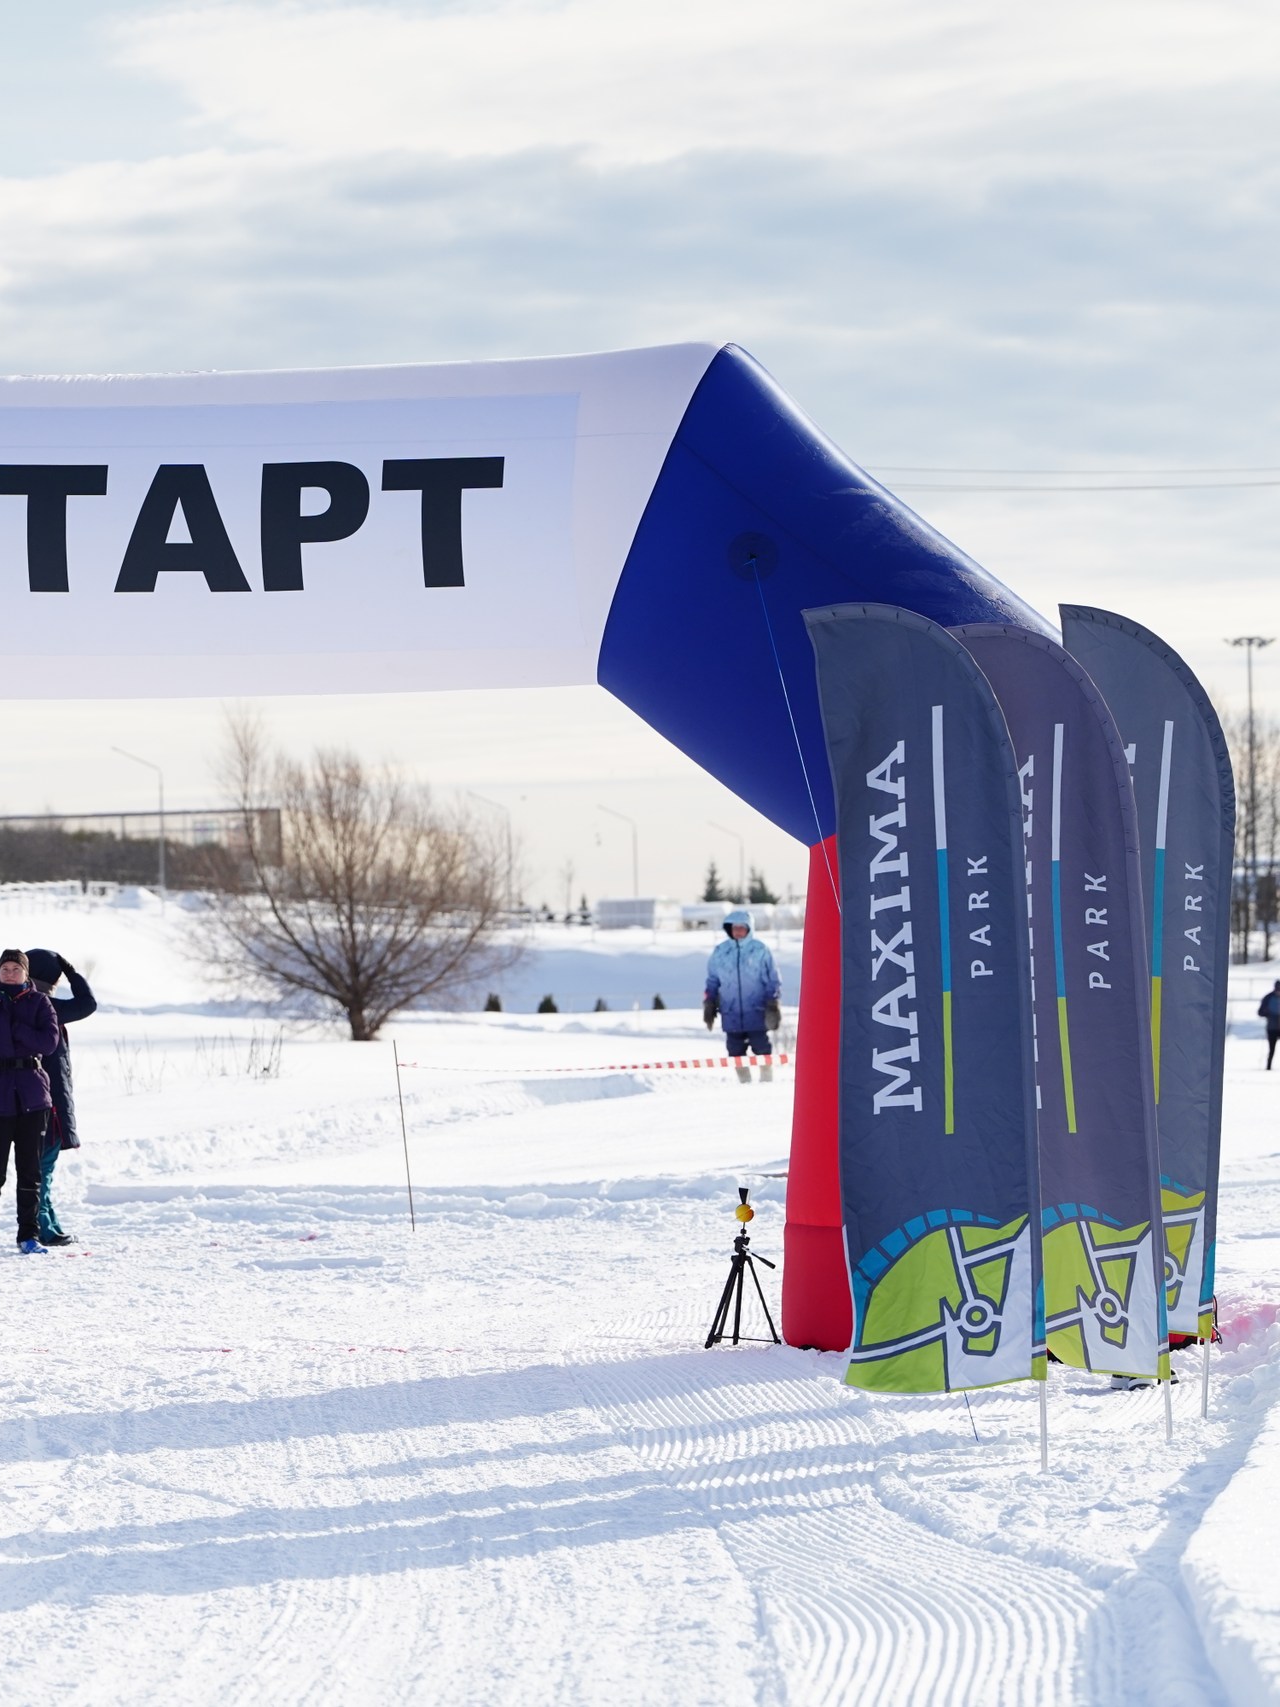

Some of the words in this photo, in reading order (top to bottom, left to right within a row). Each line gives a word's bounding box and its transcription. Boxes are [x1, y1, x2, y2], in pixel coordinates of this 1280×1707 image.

[866, 740, 923, 1114] MAXIMA
[968, 855, 993, 978] PARK
[1084, 872, 1112, 989] PARK
[1184, 862, 1204, 972] PARK
